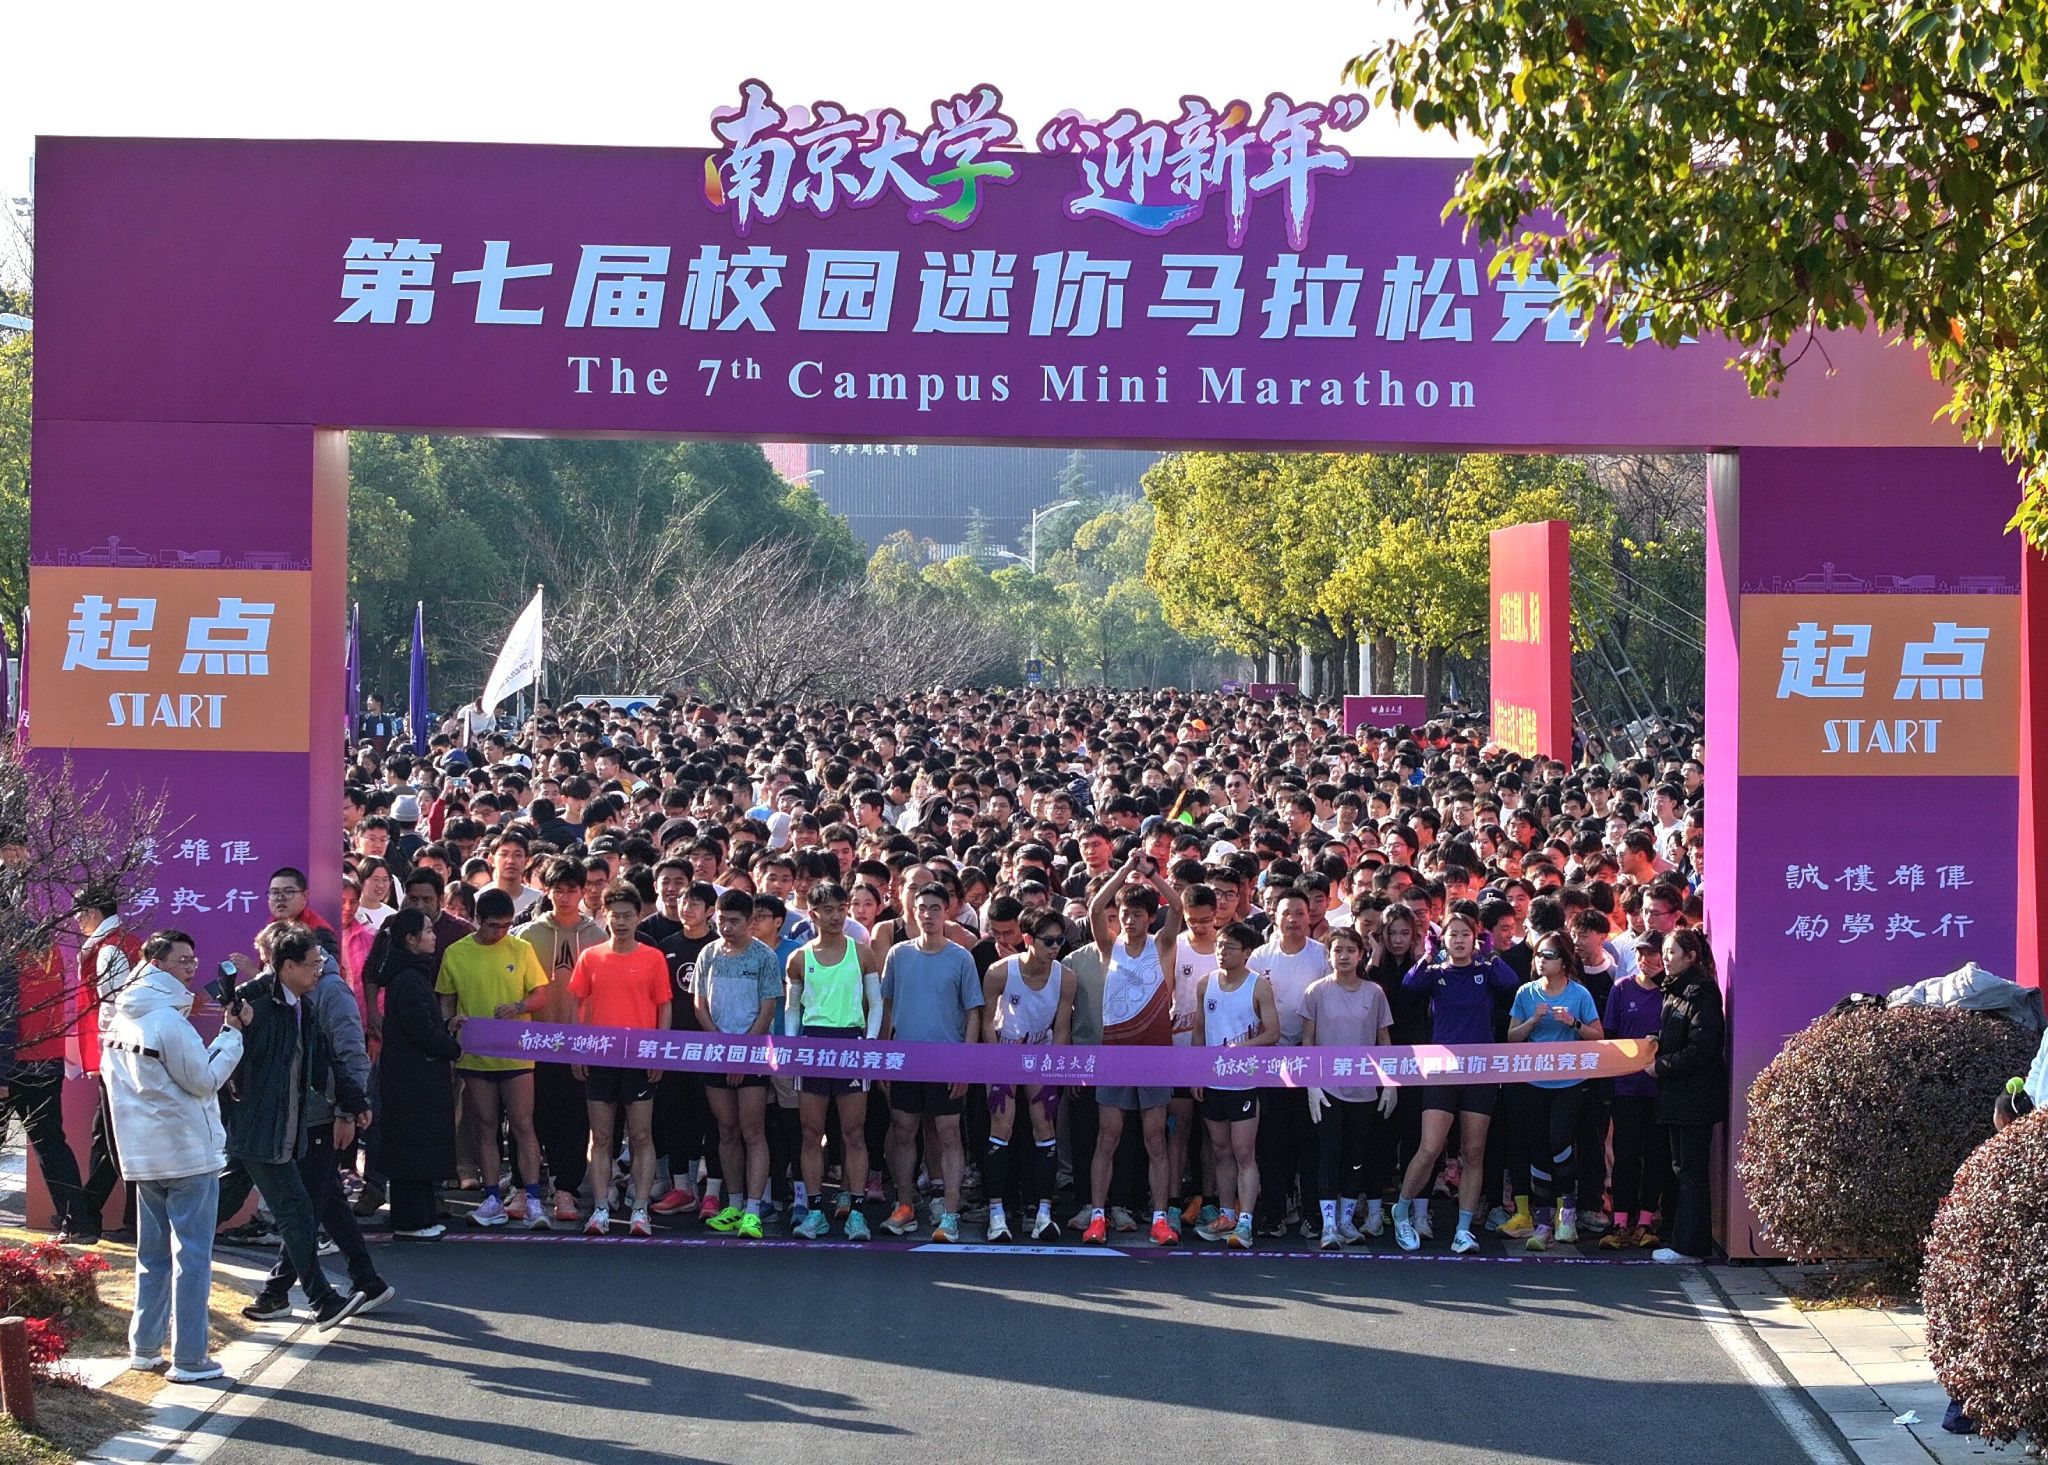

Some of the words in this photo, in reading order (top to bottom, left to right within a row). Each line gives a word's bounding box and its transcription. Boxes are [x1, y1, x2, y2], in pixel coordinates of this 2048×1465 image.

[704, 83, 1015, 231] 南京大学
[333, 237, 1700, 344] 第七届校园迷你马拉松竞
[567, 356, 669, 395] The
[698, 358, 762, 397] 7th
[788, 360, 1010, 412] Campus
[1040, 364, 1169, 403] Mini
[1198, 366, 1476, 408] Marathon
[62, 595, 275, 676] 起点
[1776, 622, 1990, 700] 起点
[106, 692, 228, 728] START
[1822, 719, 1942, 754] START
[637, 1039, 907, 1072] 第七届校园迷你马拉松竞赛
